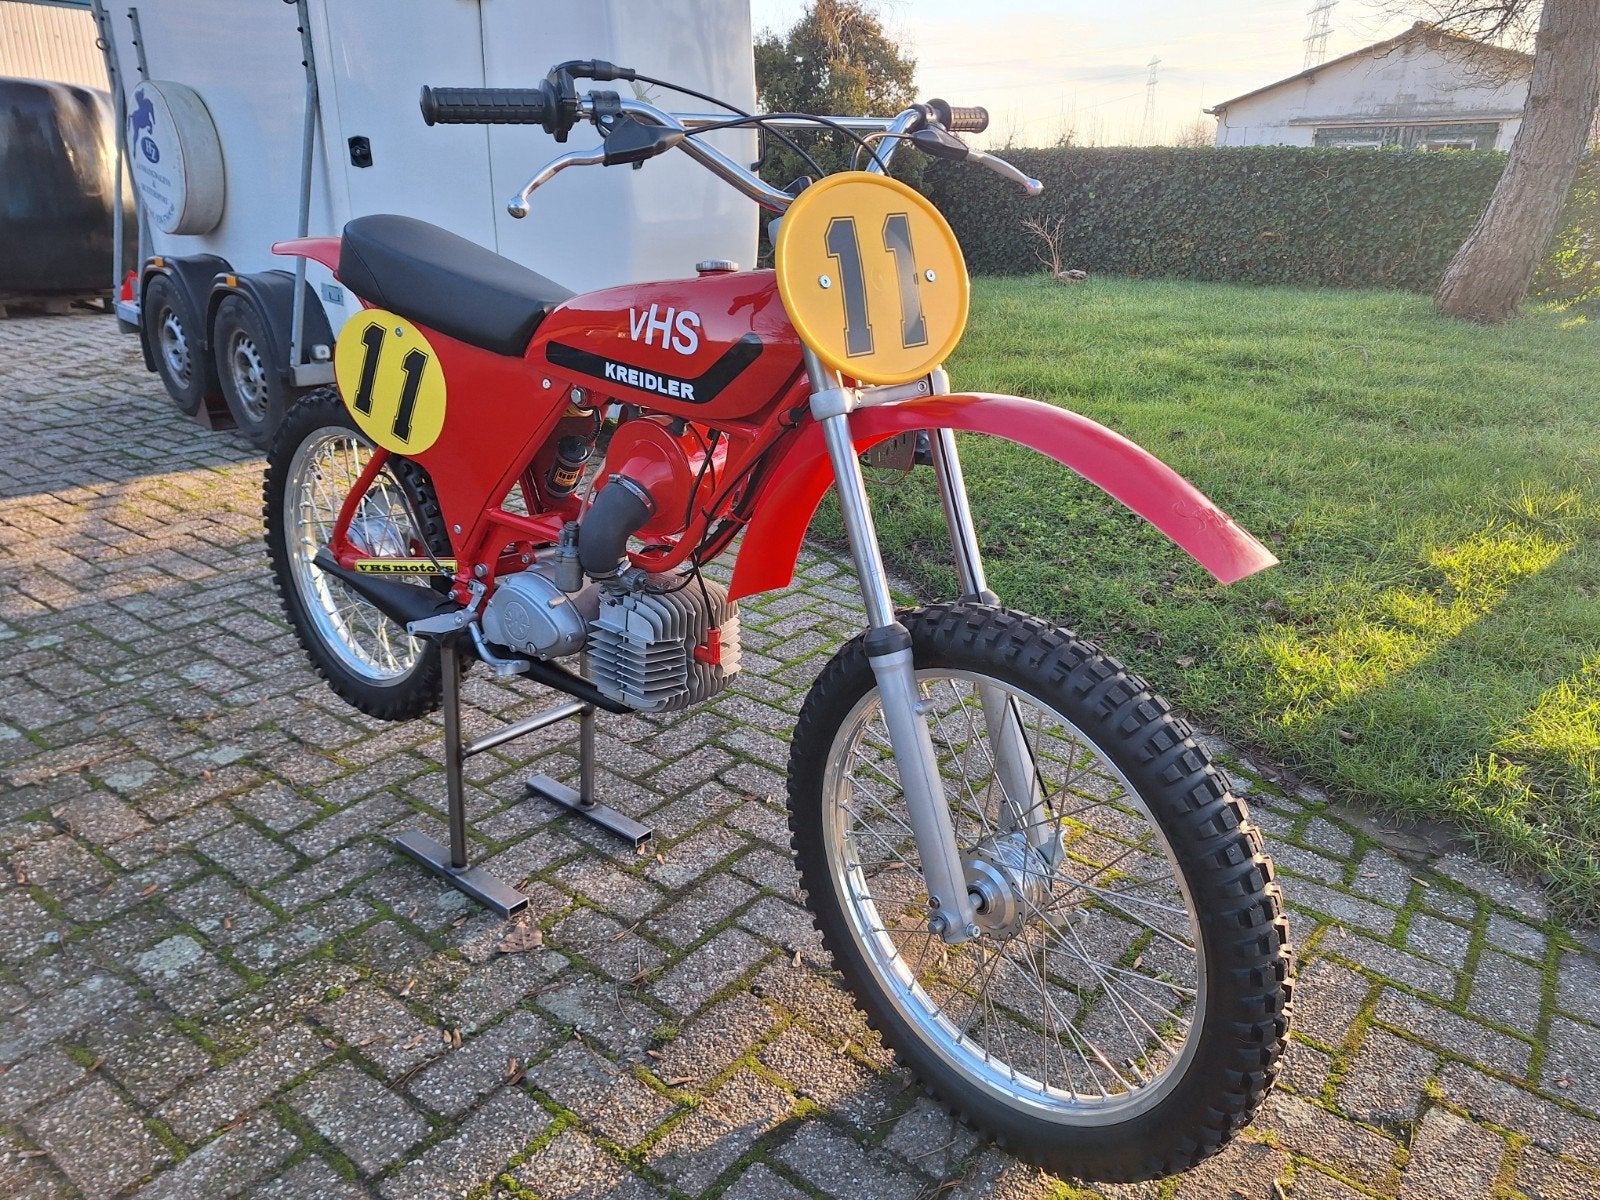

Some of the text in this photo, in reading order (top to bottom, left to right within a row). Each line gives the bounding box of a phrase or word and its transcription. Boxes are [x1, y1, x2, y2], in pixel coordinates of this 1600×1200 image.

[824, 212, 928, 358] 11
[353, 321, 429, 444] 11
[605, 361, 696, 400] KREIDLER
[358, 564, 391, 572] VHS
